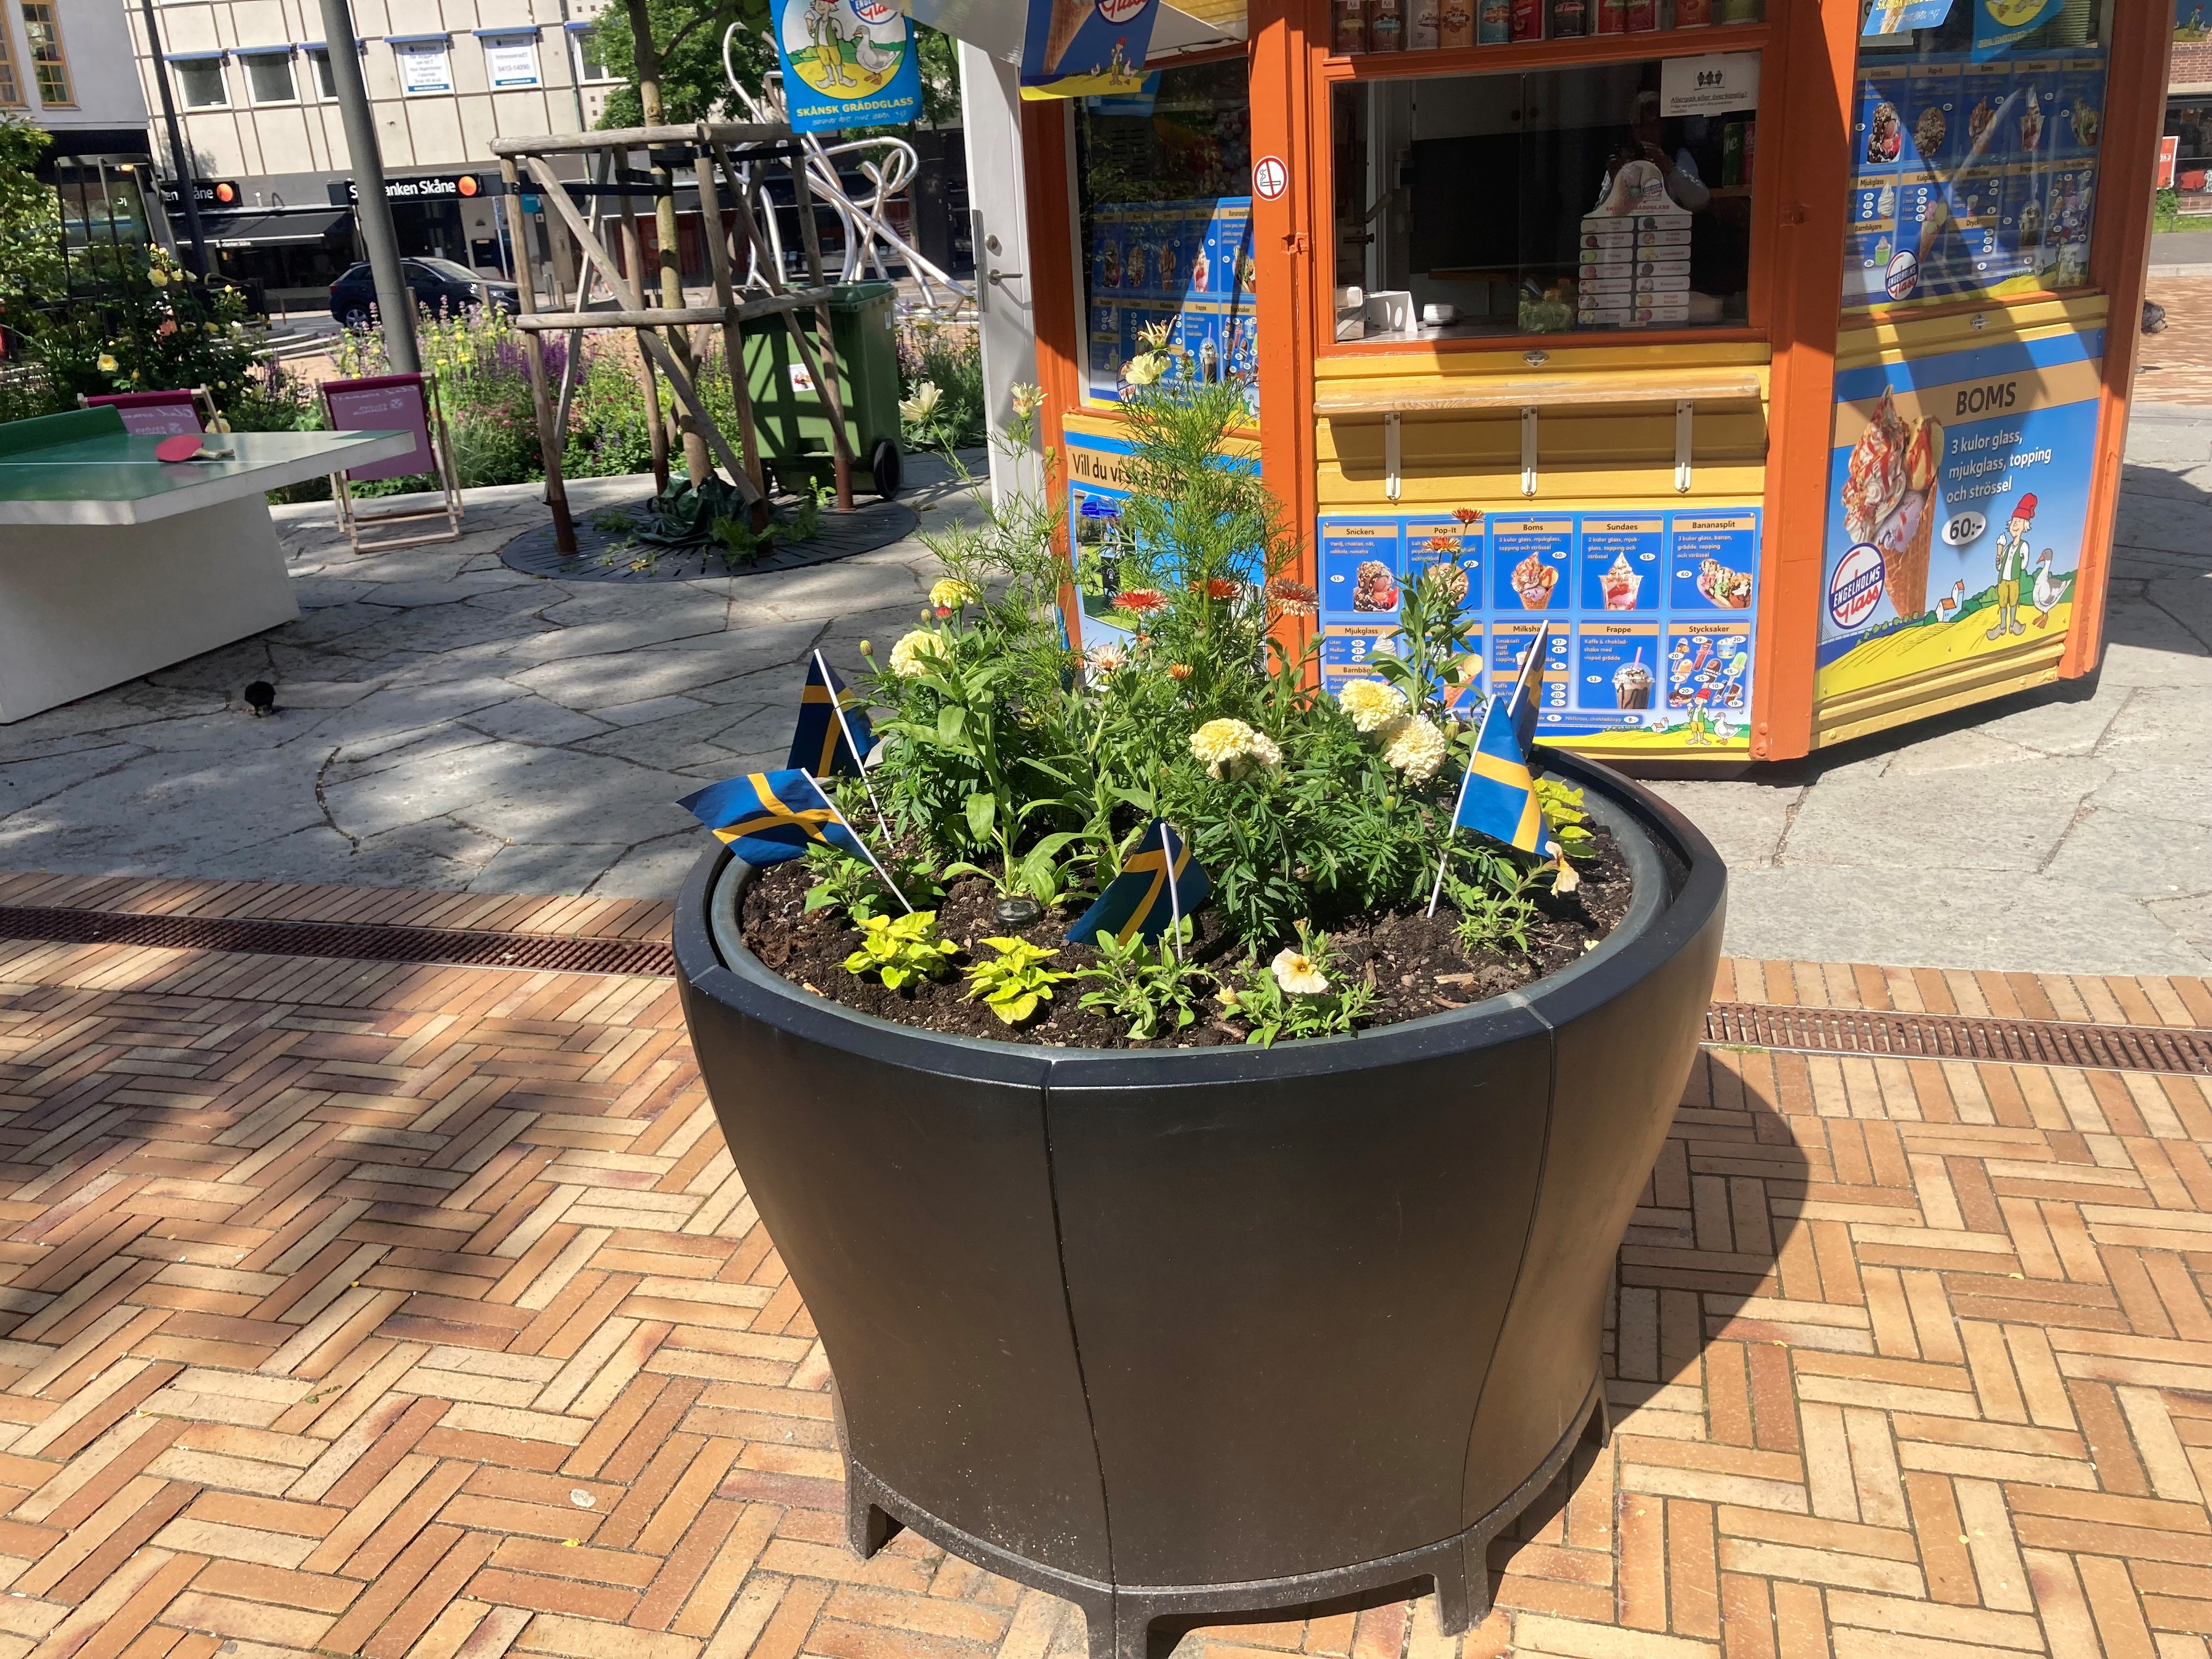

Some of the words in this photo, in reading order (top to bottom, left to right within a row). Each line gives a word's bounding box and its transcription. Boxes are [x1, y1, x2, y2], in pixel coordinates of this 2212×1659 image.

[797, 105, 839, 117] SKÅNSK
[842, 97, 913, 112] GRÄDDGLASS
[420, 179, 456, 194] Skåne
[1888, 265, 1916, 287] ENGELHOLMS
[1956, 381, 2016, 416] BOMS
[1951, 439, 1959, 455] 3
[1961, 434, 1990, 453] kulor
[1992, 429, 2023, 451] glass,
[1072, 453, 1090, 477] Vill
[1093, 457, 1107, 480] du
[1949, 456, 2006, 481] mjukglass,
[2010, 447, 2052, 469] topping
[1946, 485, 1967, 503] och
[1969, 475, 2013, 499] strössel
[1692, 521, 1735, 529] Bananasplit
[1949, 517, 1982, 540] 60:-
[1833, 566, 1881, 608] ENGELHOLMS
[1689, 625, 1730, 634] Stycksaker
